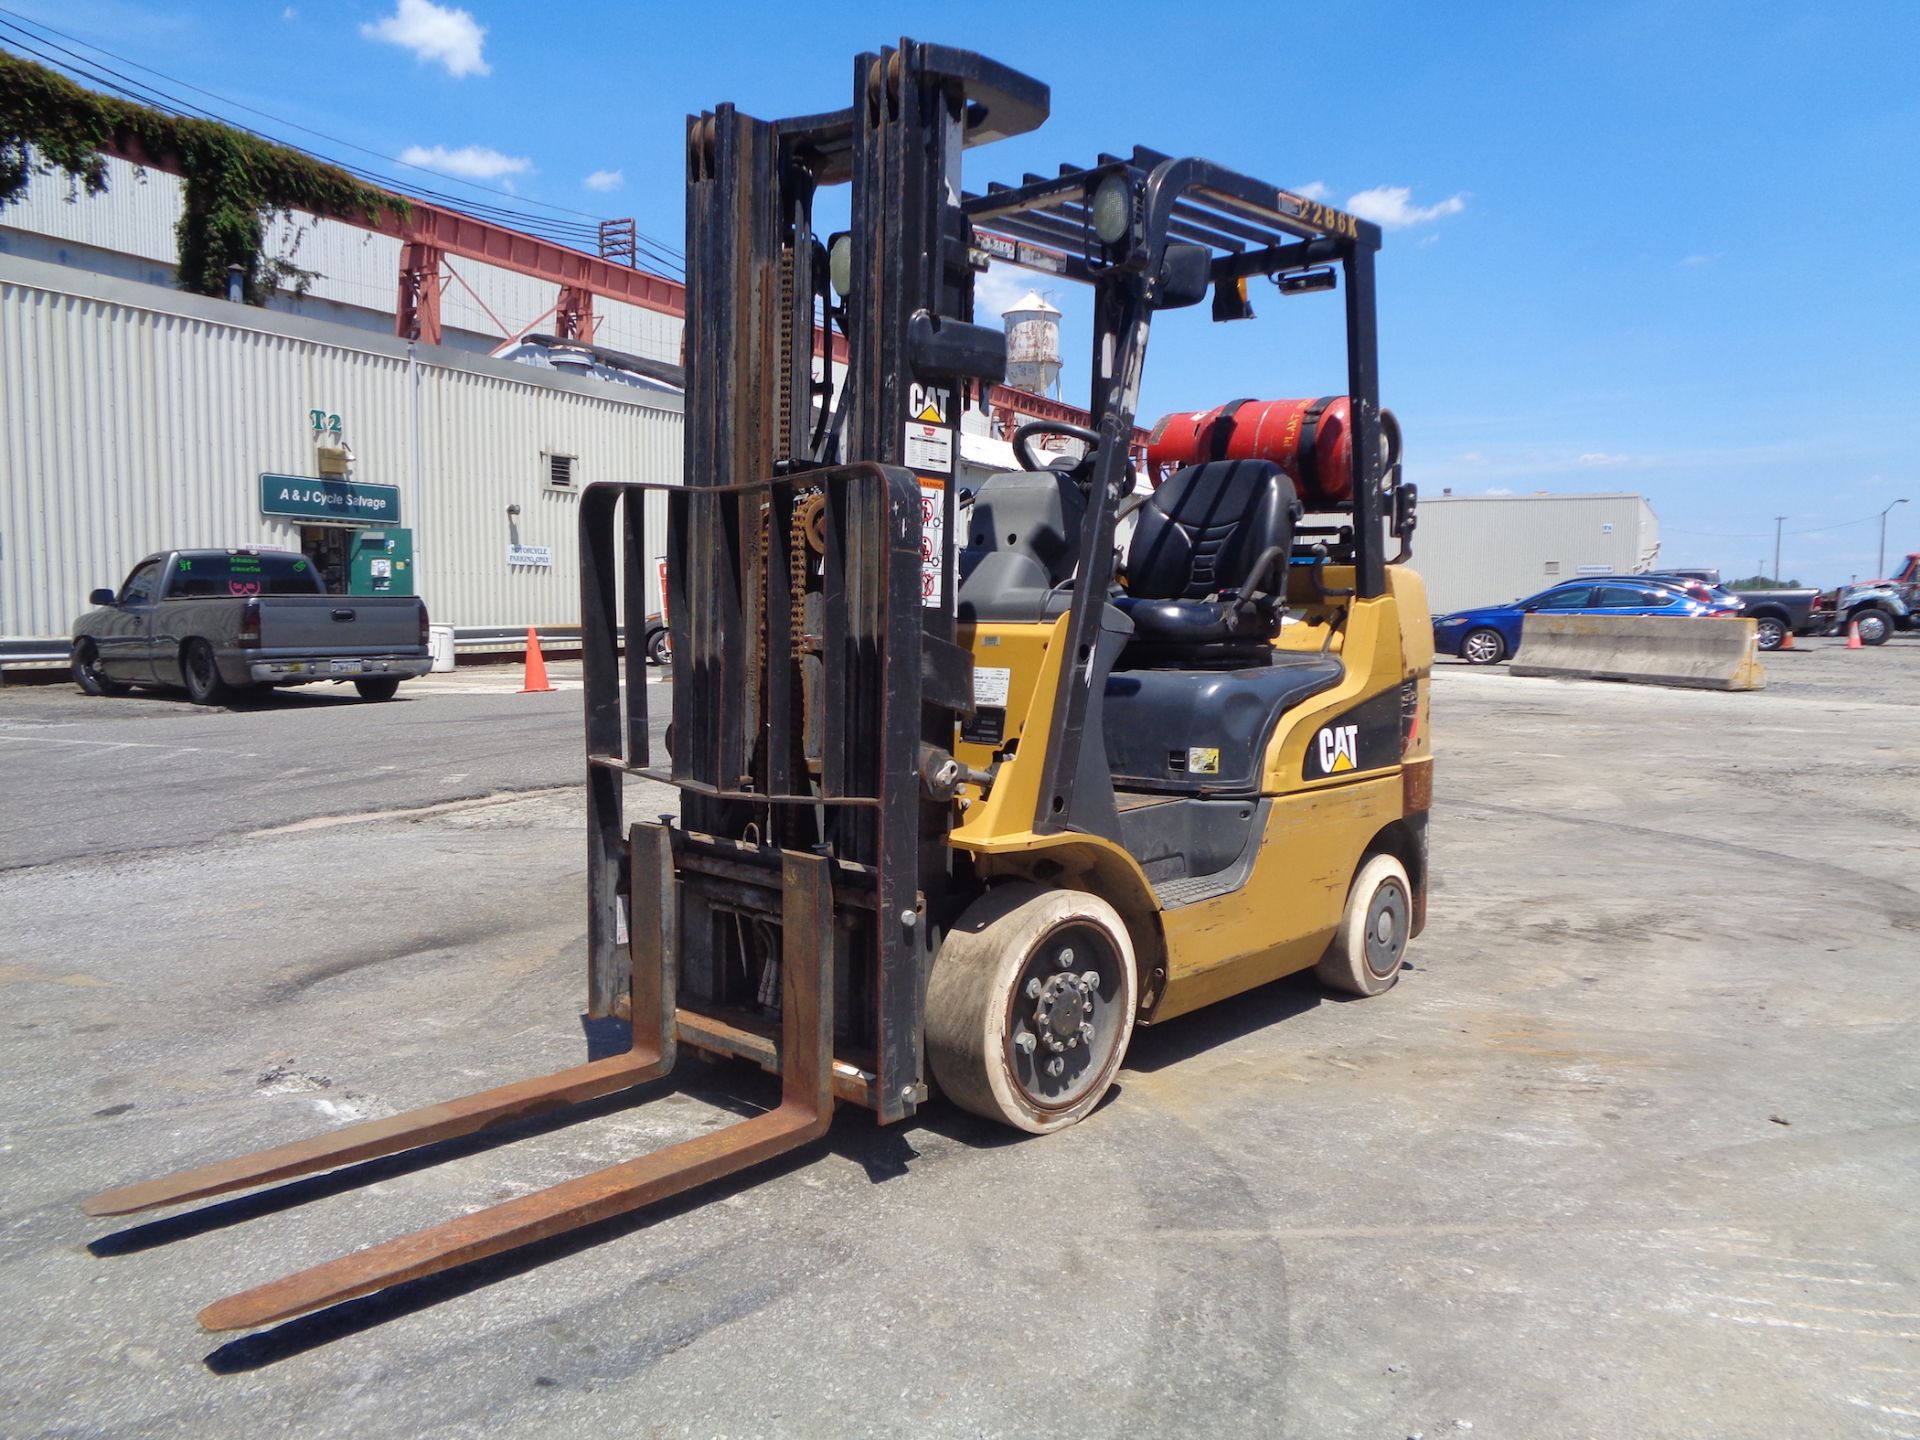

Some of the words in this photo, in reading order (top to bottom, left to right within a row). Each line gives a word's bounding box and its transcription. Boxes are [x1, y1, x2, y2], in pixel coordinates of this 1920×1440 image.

[909, 382, 950, 424] CAT
[280, 488, 289, 500] A
[292, 490, 300, 501] &
[303, 490, 310, 501] J
[312, 491, 343, 506] Cycle
[345, 494, 386, 510] Salvage
[1319, 724, 1358, 774] CAT
